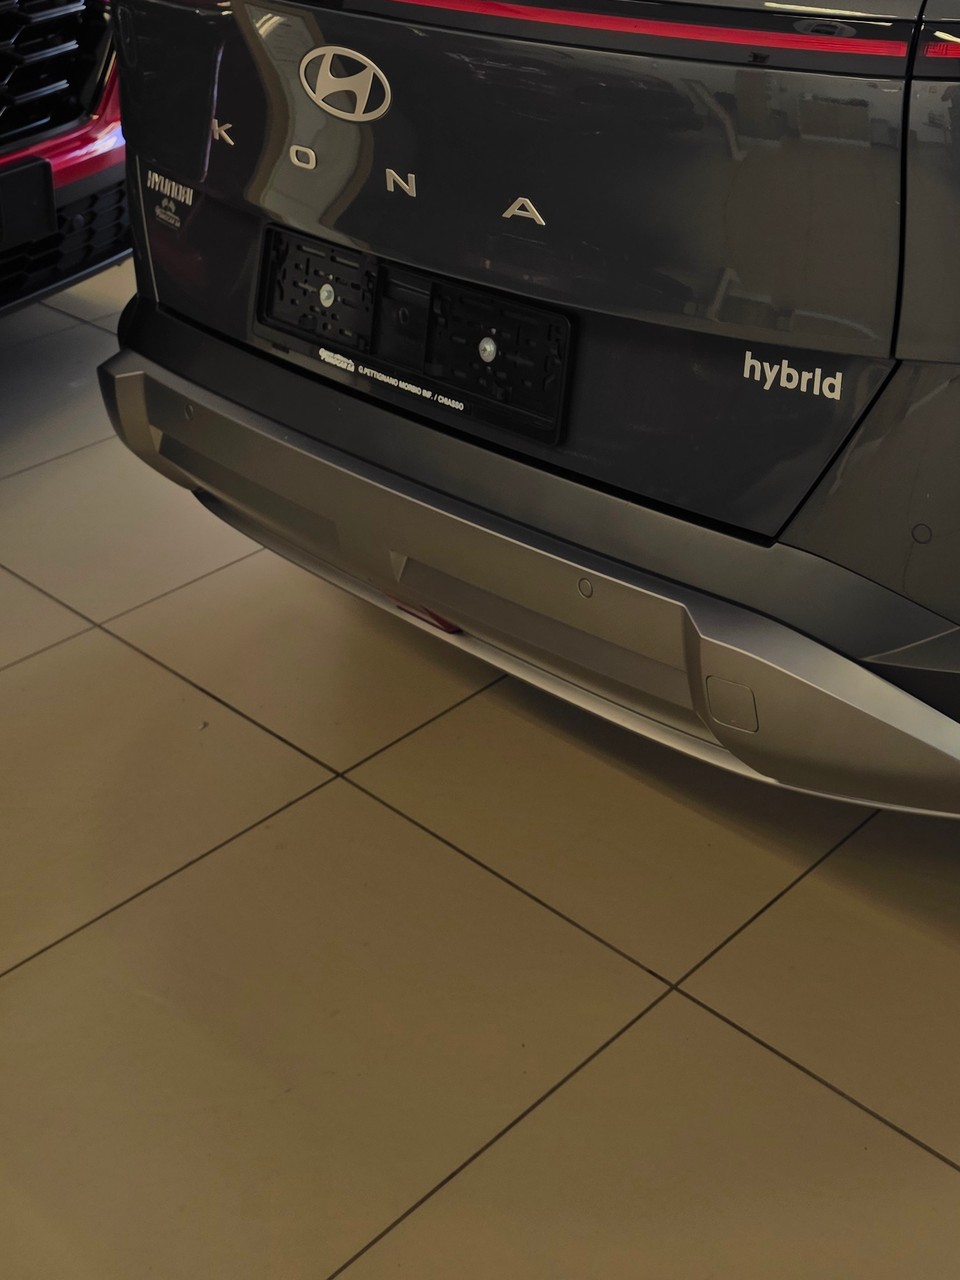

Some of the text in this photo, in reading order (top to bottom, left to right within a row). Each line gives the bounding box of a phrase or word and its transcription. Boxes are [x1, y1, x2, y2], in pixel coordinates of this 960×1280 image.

[147, 170, 194, 206] HYUNDAI
[210, 118, 546, 226] KONA
[743, 350, 843, 400] hybrid
[437, 394, 465, 411] CHIASSO
